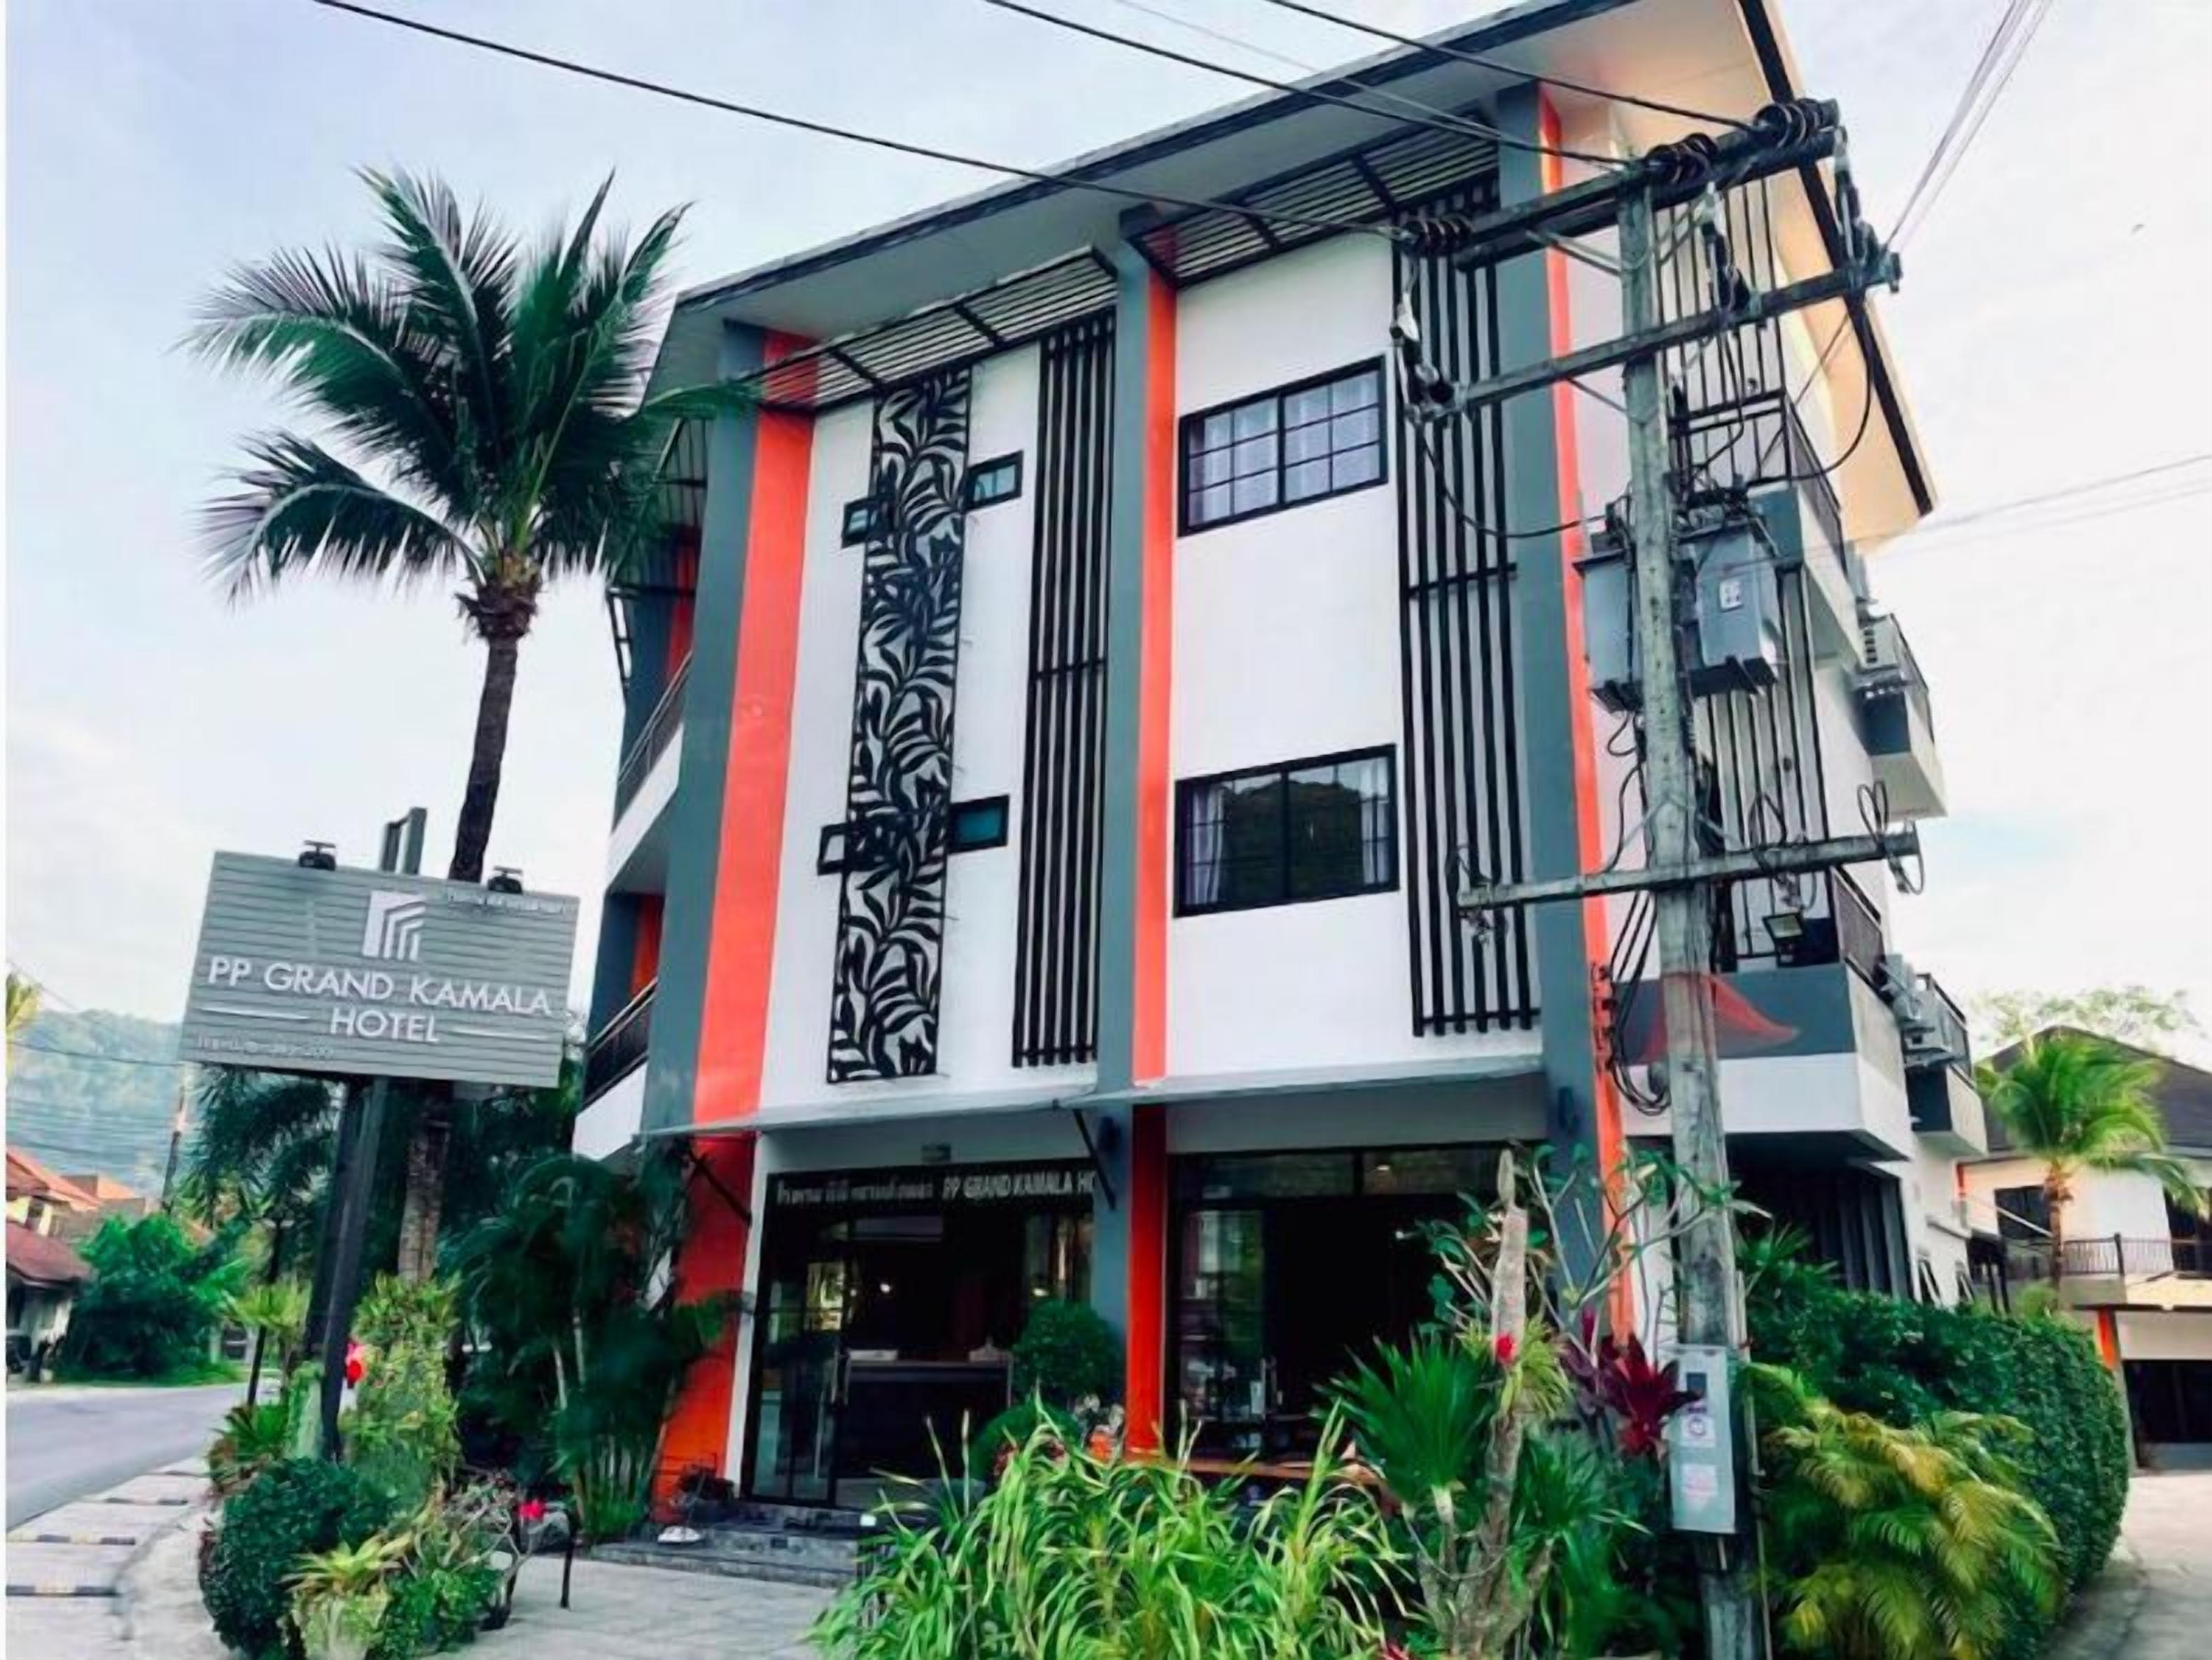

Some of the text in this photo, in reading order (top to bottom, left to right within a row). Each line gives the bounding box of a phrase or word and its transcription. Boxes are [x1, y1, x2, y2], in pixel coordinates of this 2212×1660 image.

[209, 956, 553, 1015] PP GRAND KAMALA
[330, 1007, 440, 1043] HOTEL
